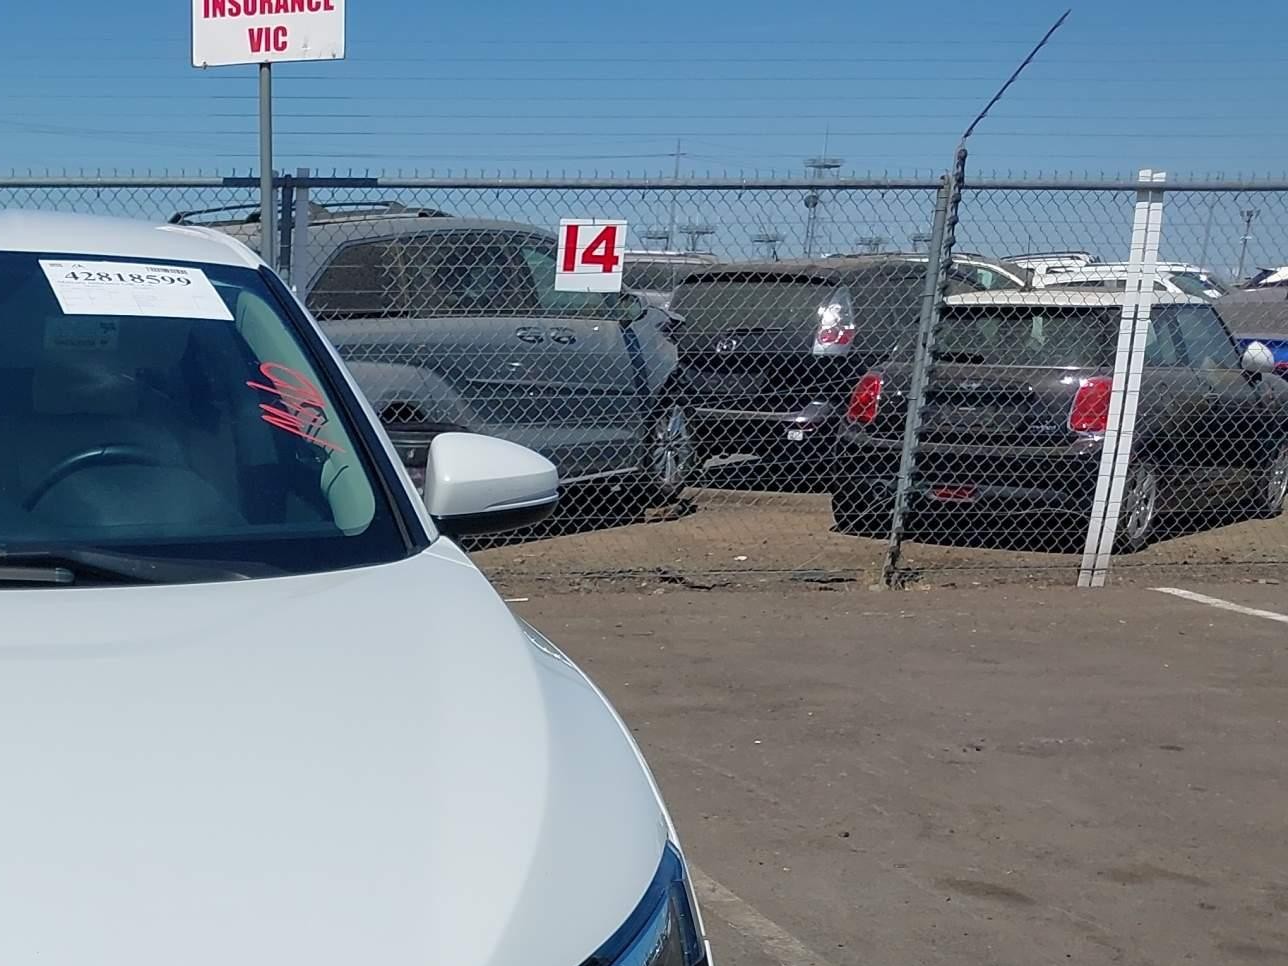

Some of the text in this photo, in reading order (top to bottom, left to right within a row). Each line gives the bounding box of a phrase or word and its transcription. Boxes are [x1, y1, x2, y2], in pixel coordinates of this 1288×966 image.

[248, 26, 288, 53] VIC
[563, 225, 619, 273] 14
[64, 271, 192, 287] 42818599
